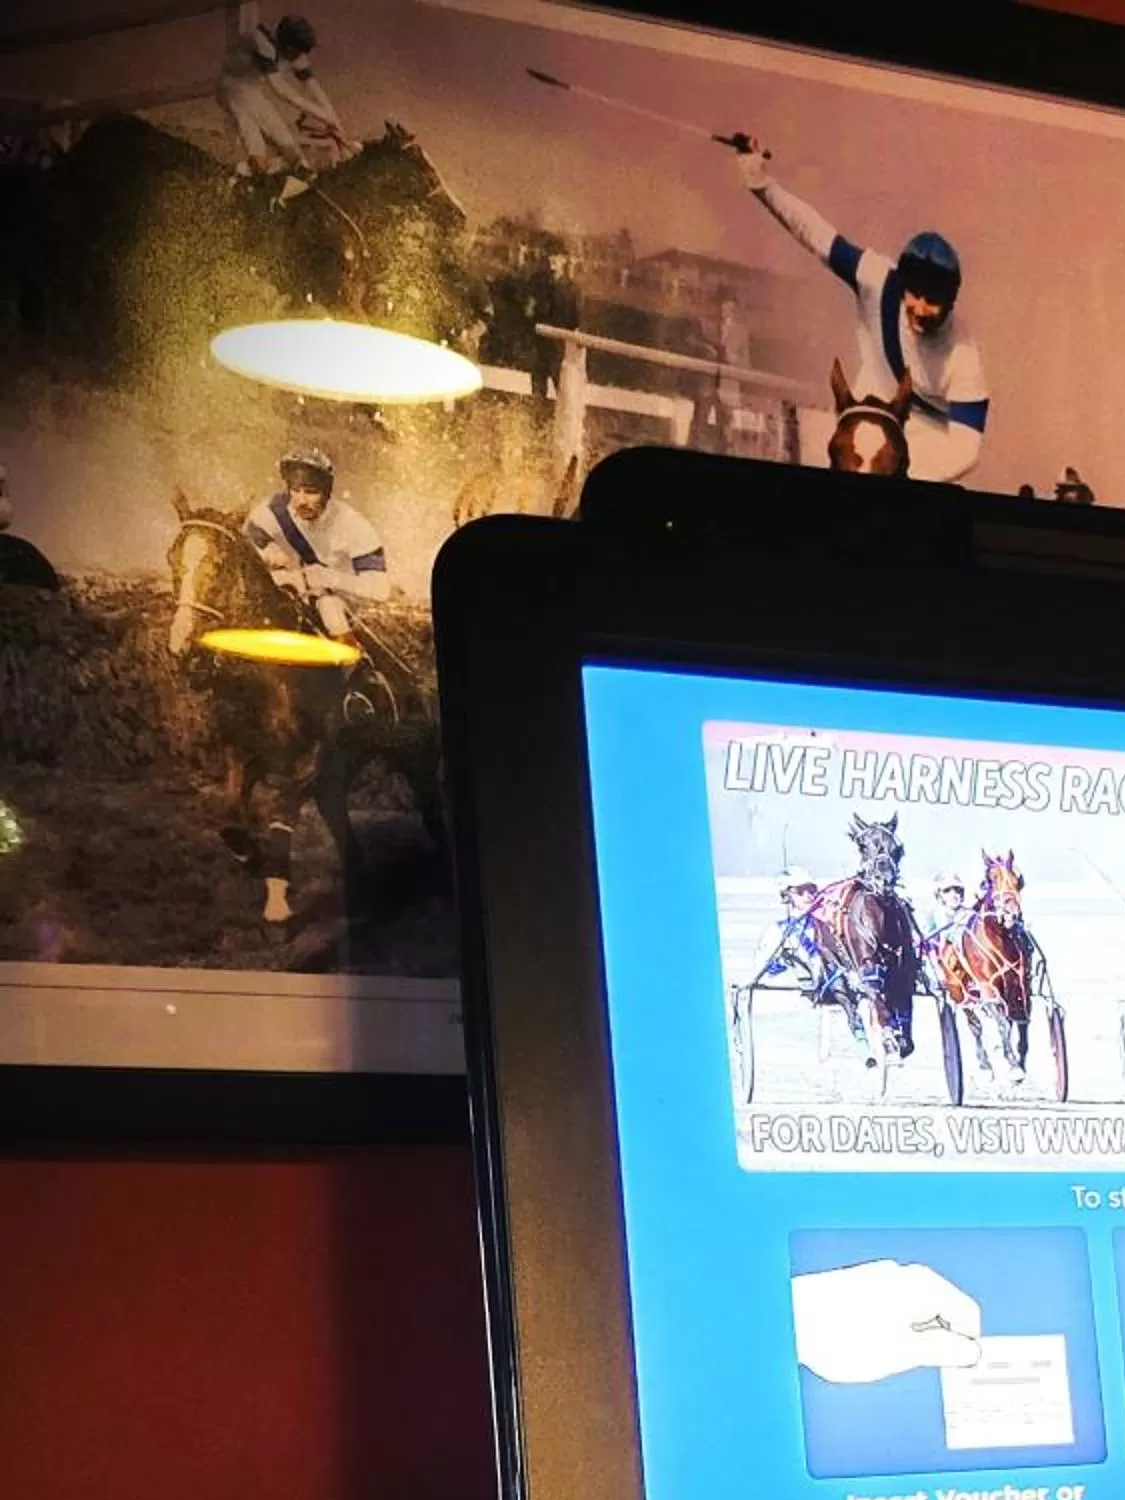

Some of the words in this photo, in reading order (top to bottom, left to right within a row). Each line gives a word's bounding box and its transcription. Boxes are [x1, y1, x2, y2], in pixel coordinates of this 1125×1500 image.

[724, 740, 831, 797] LIVE
[840, 749, 1053, 812] HARNESS
[750, 1115, 826, 1154] FOR
[830, 1116, 945, 1157] DATES,
[946, 1116, 1031, 1154] VISIT
[1071, 1185, 1101, 1209] To
